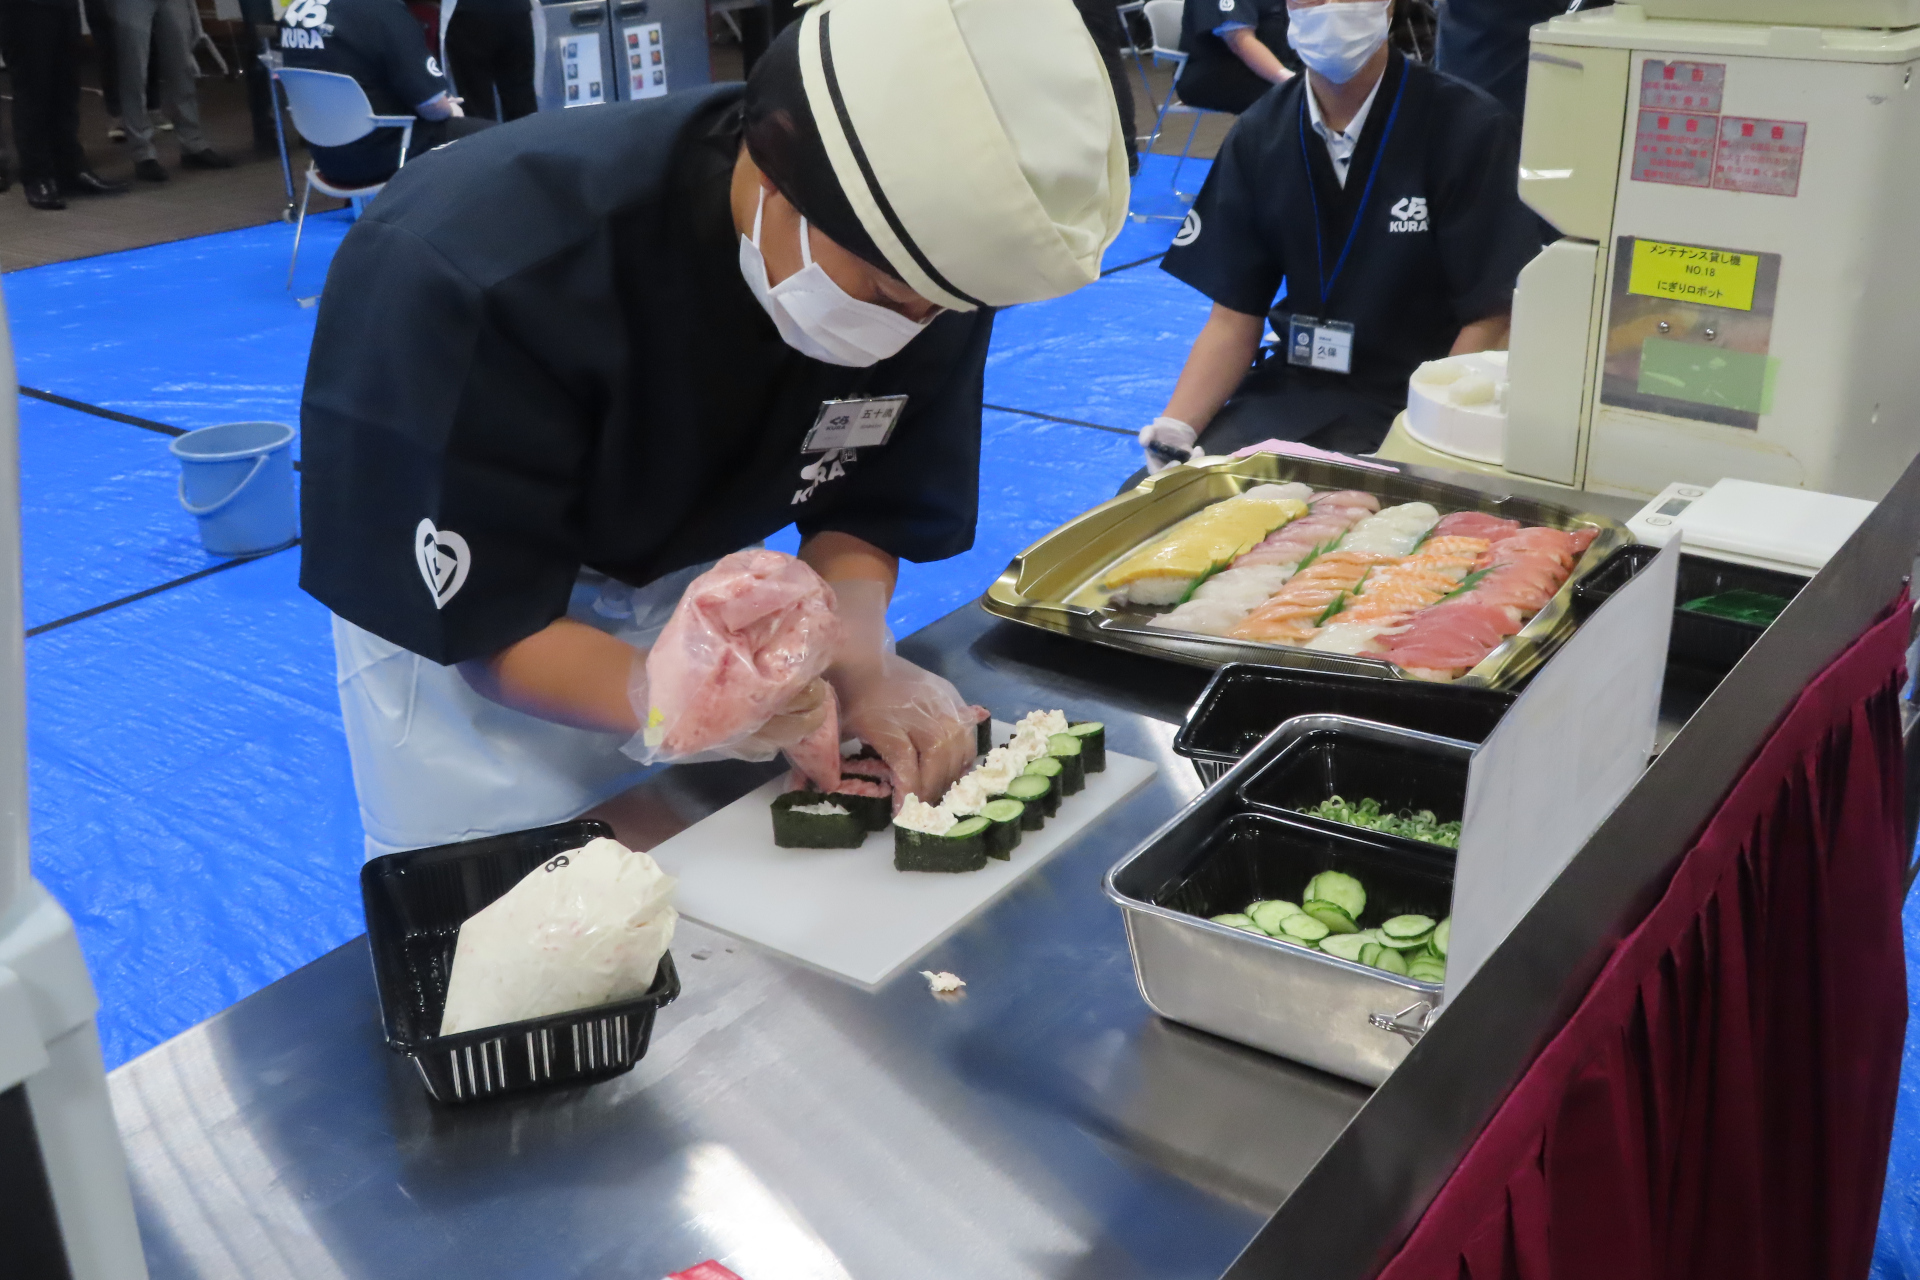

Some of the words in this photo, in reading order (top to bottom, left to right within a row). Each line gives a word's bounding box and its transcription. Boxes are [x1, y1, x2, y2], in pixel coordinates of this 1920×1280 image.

[281, 28, 325, 49] KURA
[1389, 220, 1429, 233] KURA
[1650, 245, 1741, 266] メンテナンス貸し機
[1657, 280, 1723, 298] にぎりロボット
